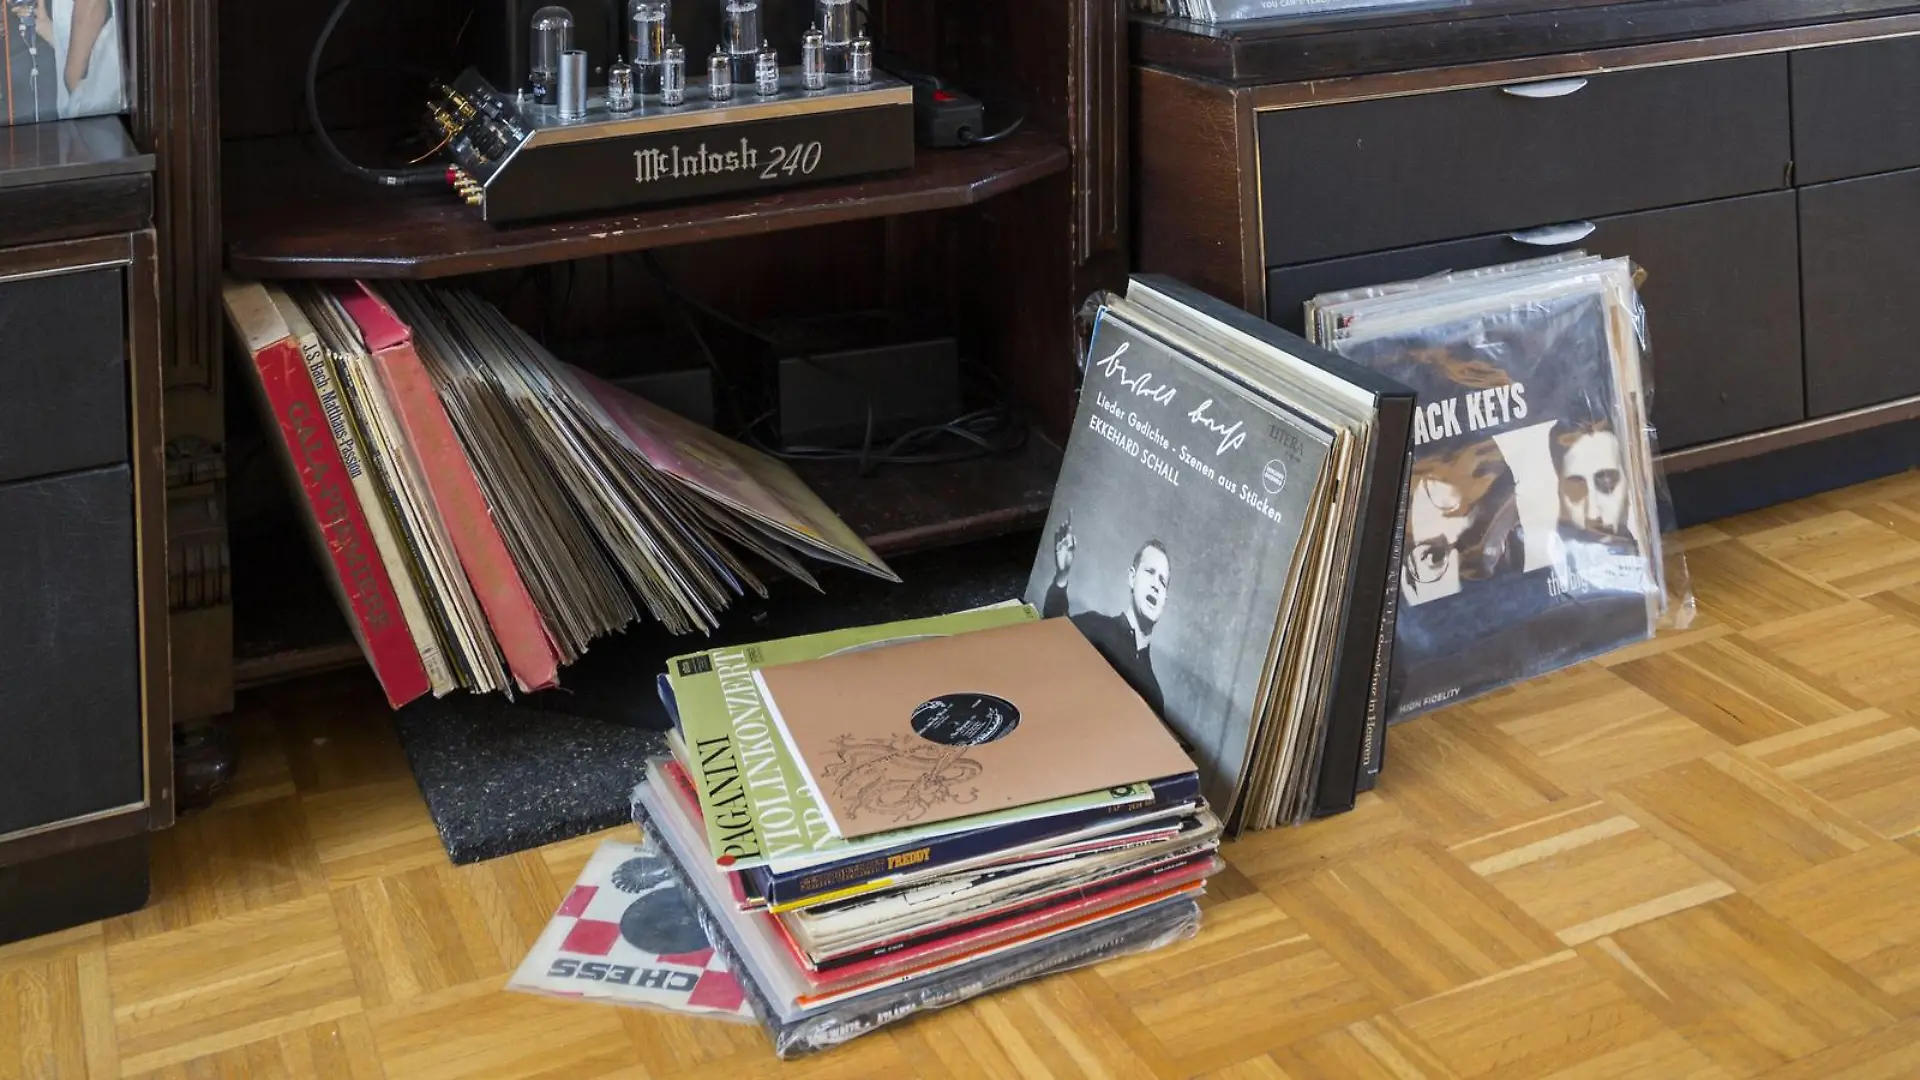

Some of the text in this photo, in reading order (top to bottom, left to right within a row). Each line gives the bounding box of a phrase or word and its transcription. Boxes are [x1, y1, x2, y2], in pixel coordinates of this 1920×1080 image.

[634, 138, 822, 183] McIntosh 240
[310, 360, 331, 389] Bach
[1465, 382, 1527, 431] KEYS
[1089, 414, 1180, 486] EKKEHARD SCHALL
[1096, 391, 1283, 523] Lieder Gedichte Szenen aus Stücken
[1423, 687, 1461, 709] FIDELITY
[713, 650, 803, 858] VIOLINKONZERT
[1363, 715, 1377, 766] Heaven
[696, 734, 763, 860] PAGANINI
[547, 957, 700, 992] CHESS
